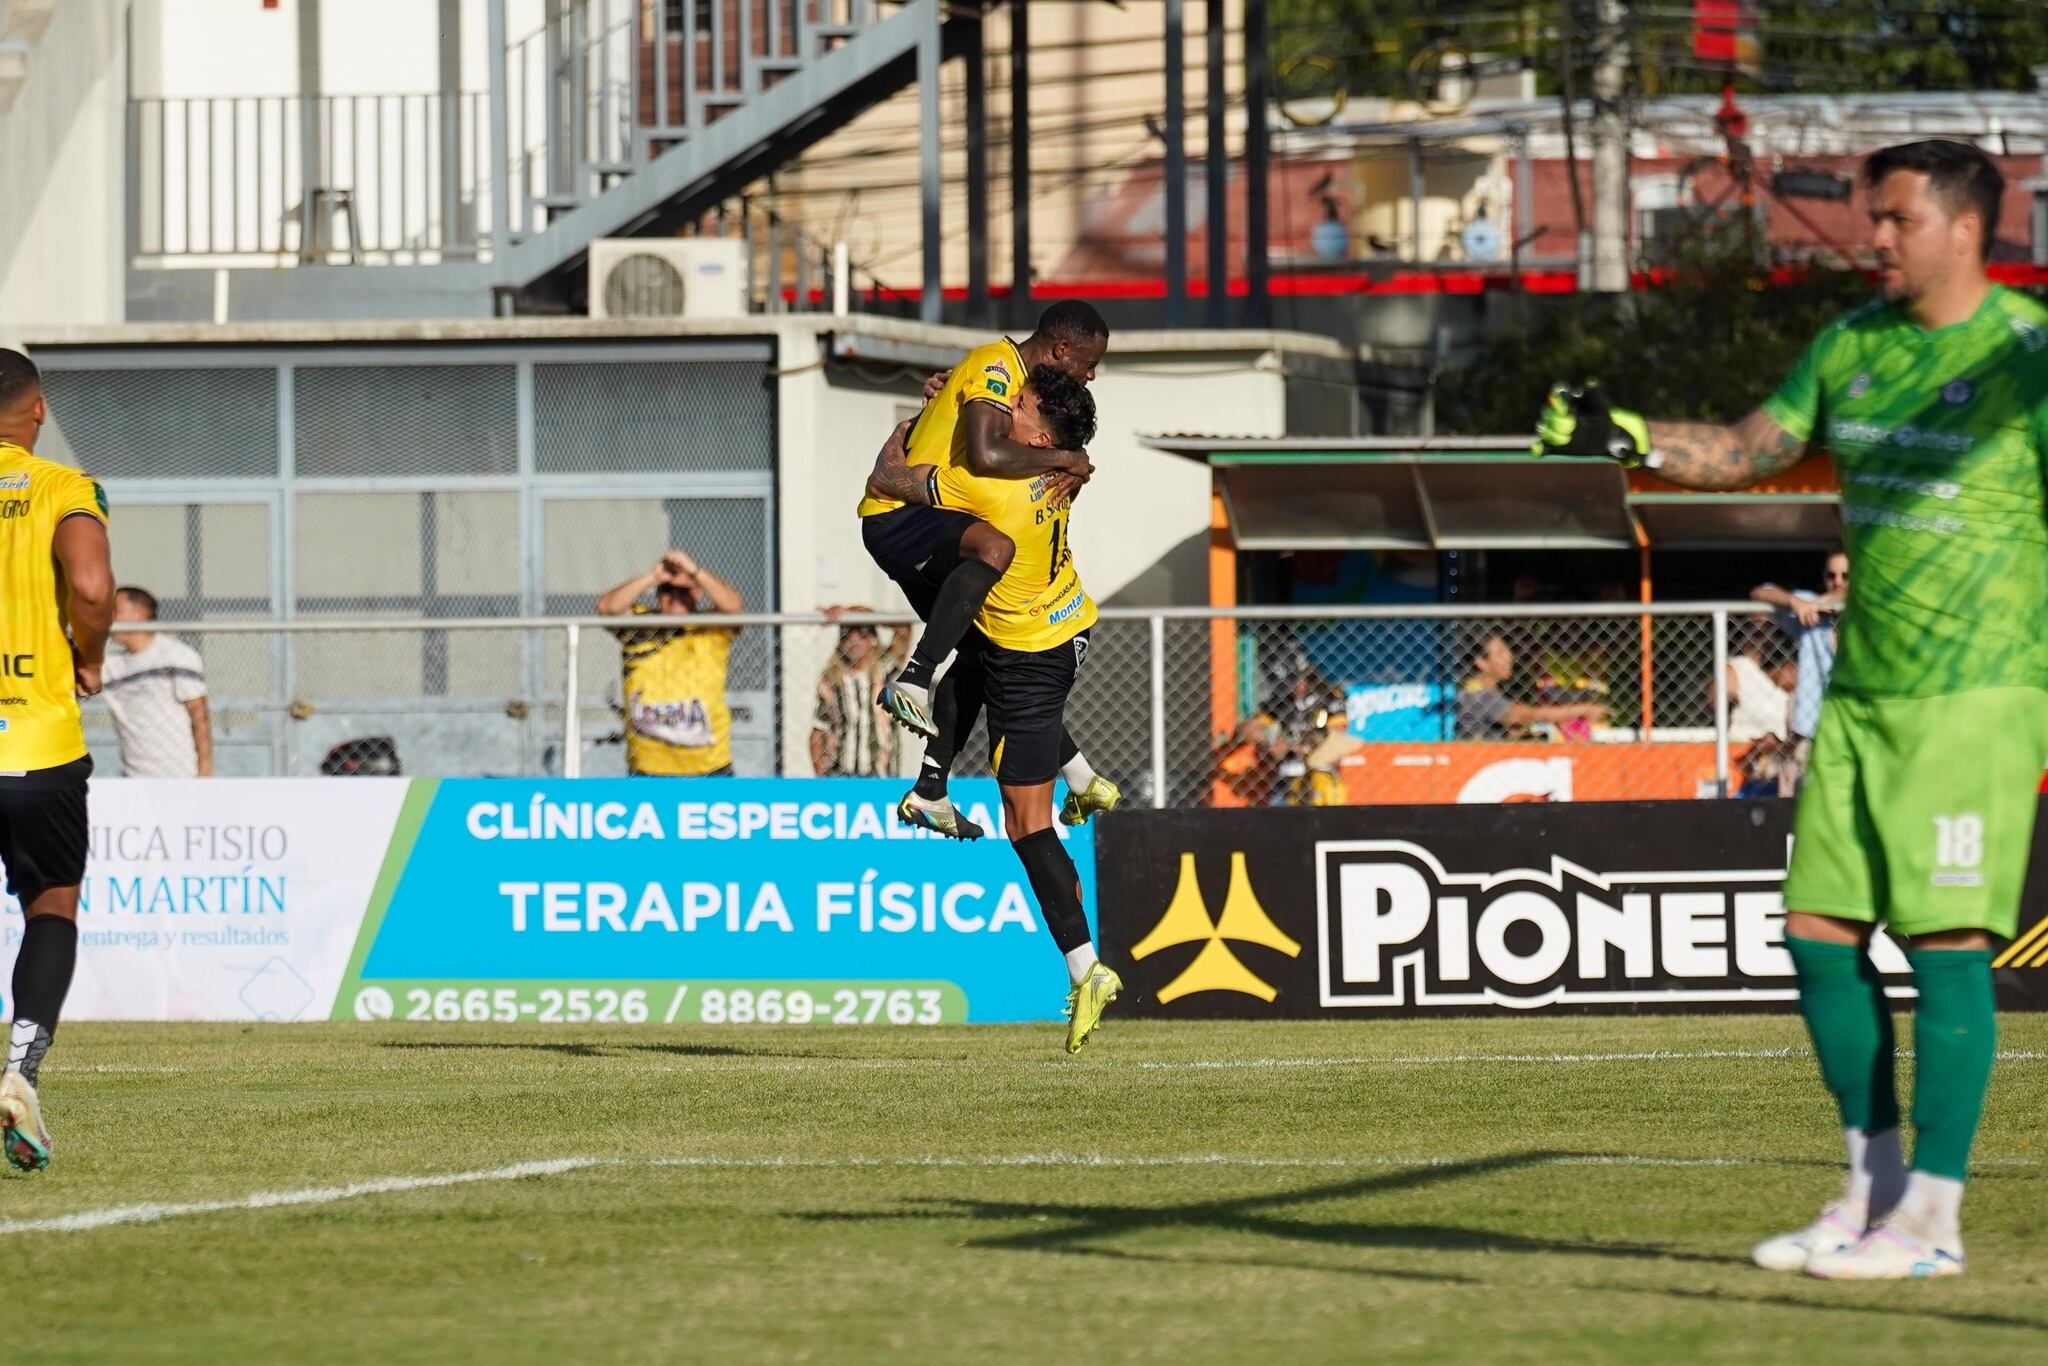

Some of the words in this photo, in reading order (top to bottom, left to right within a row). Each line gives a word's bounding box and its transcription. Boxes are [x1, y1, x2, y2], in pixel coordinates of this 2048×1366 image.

[1049, 591, 1083, 624] Monta
[2, 654, 34, 678] IC
[466, 792, 665, 840] CLÍNICA
[183, 824, 288, 861] FISIO
[1933, 814, 1983, 868] 18
[108, 865, 287, 914] MARTÍN
[499, 881, 794, 932] TERAPIA
[816, 867, 1038, 932] FÍSICA
[82, 929, 160, 950] entrega
[165, 933, 177, 951] y
[182, 926, 290, 946] resultados
[1339, 862, 1914, 985] PIONEE
[406, 987, 649, 1024] 2665-2526
[665, 985, 688, 1024] /
[701, 988, 942, 1025] 8869-2763
